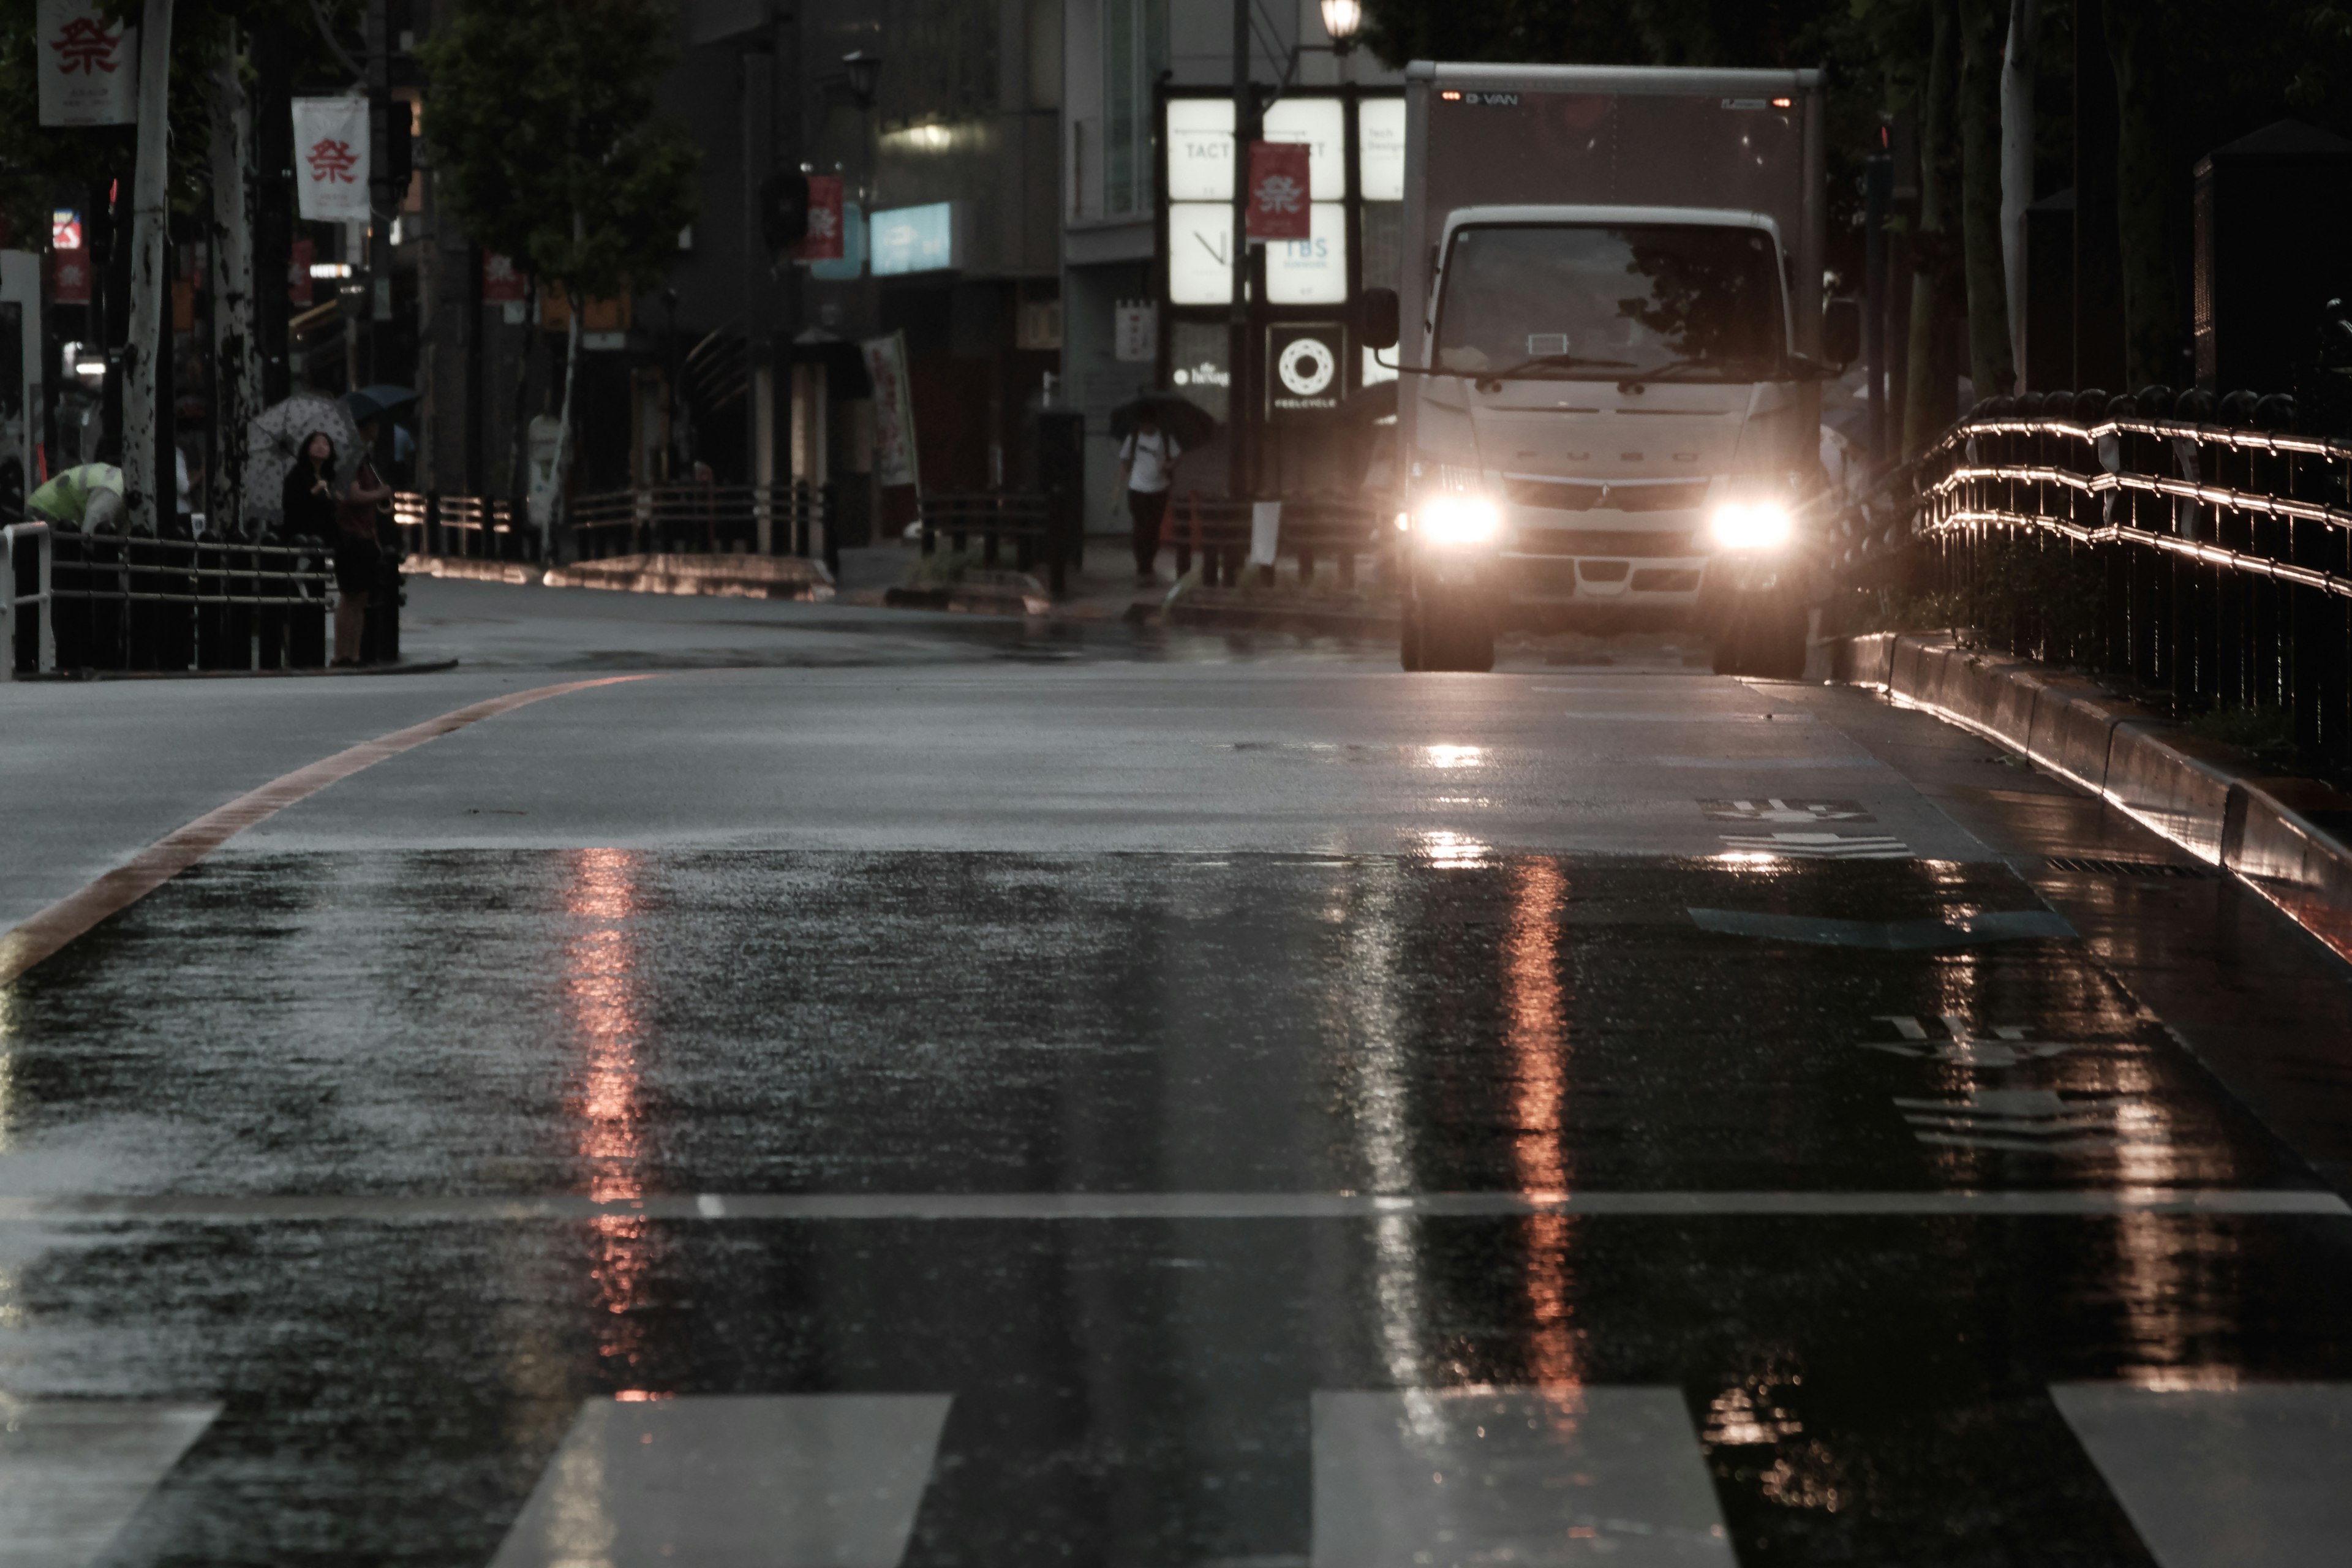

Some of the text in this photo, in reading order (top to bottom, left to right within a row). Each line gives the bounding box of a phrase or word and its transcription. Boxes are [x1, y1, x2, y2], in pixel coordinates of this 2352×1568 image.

[50, 17, 121, 76] 祭
[305, 138, 361, 184] 祭
[1186, 142, 1229, 158] TACT
[1287, 236, 1328, 257] TBS
